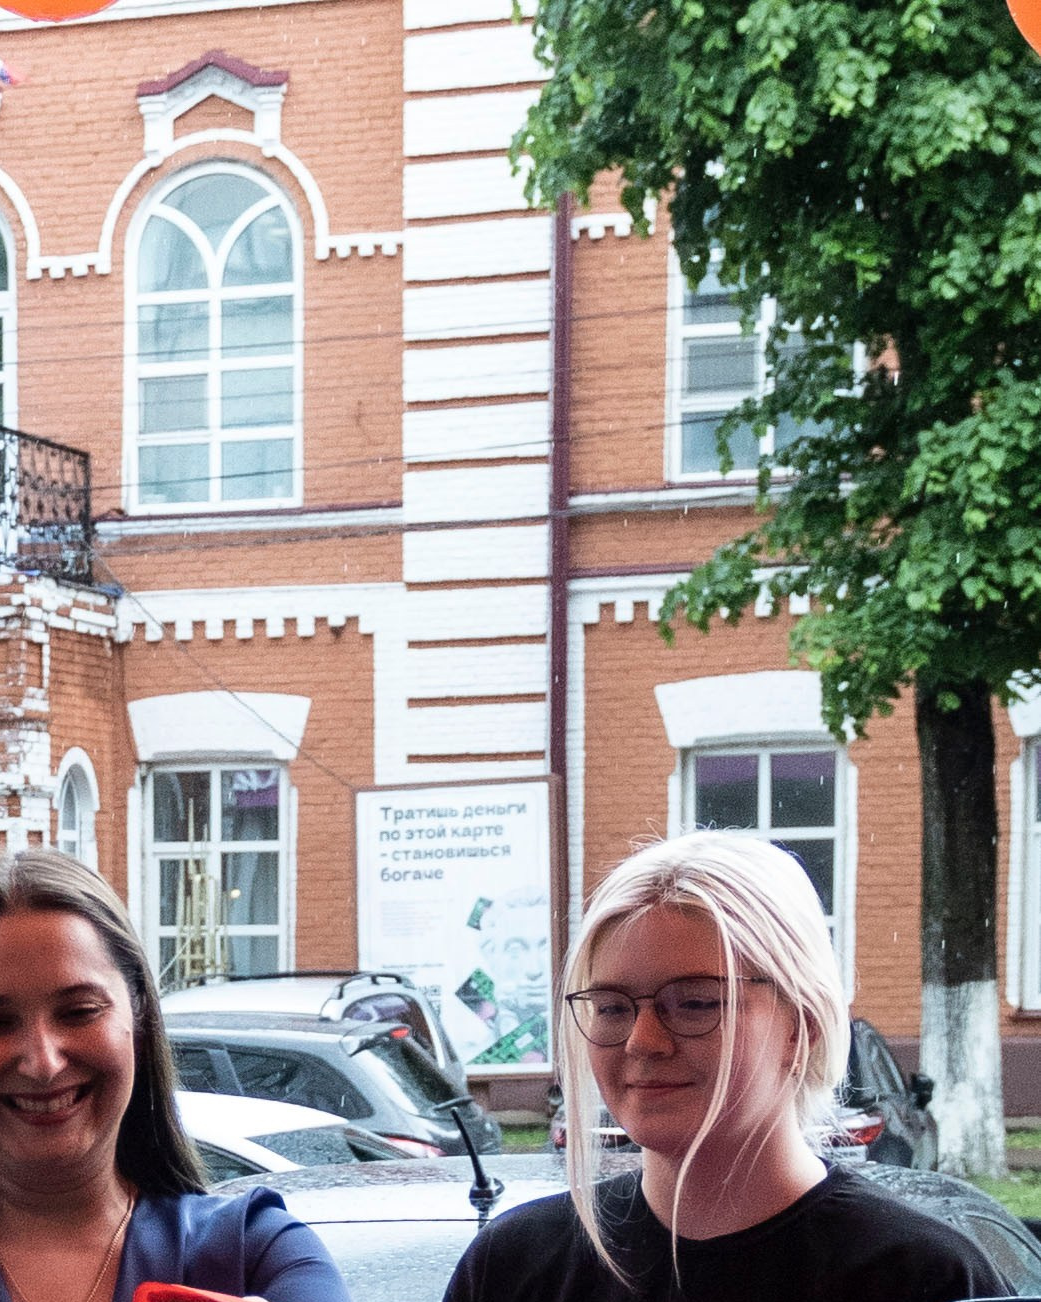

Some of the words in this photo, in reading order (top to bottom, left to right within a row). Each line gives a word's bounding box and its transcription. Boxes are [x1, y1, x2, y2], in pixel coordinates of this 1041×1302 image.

[380, 806, 458, 825] Тратишь
[463, 802, 528, 819] деньги
[379, 829, 401, 842] по
[405, 825, 446, 840] этой
[451, 824, 504, 841] карте
[391, 844, 512, 861] становишься
[380, 867, 445, 882] богаче
